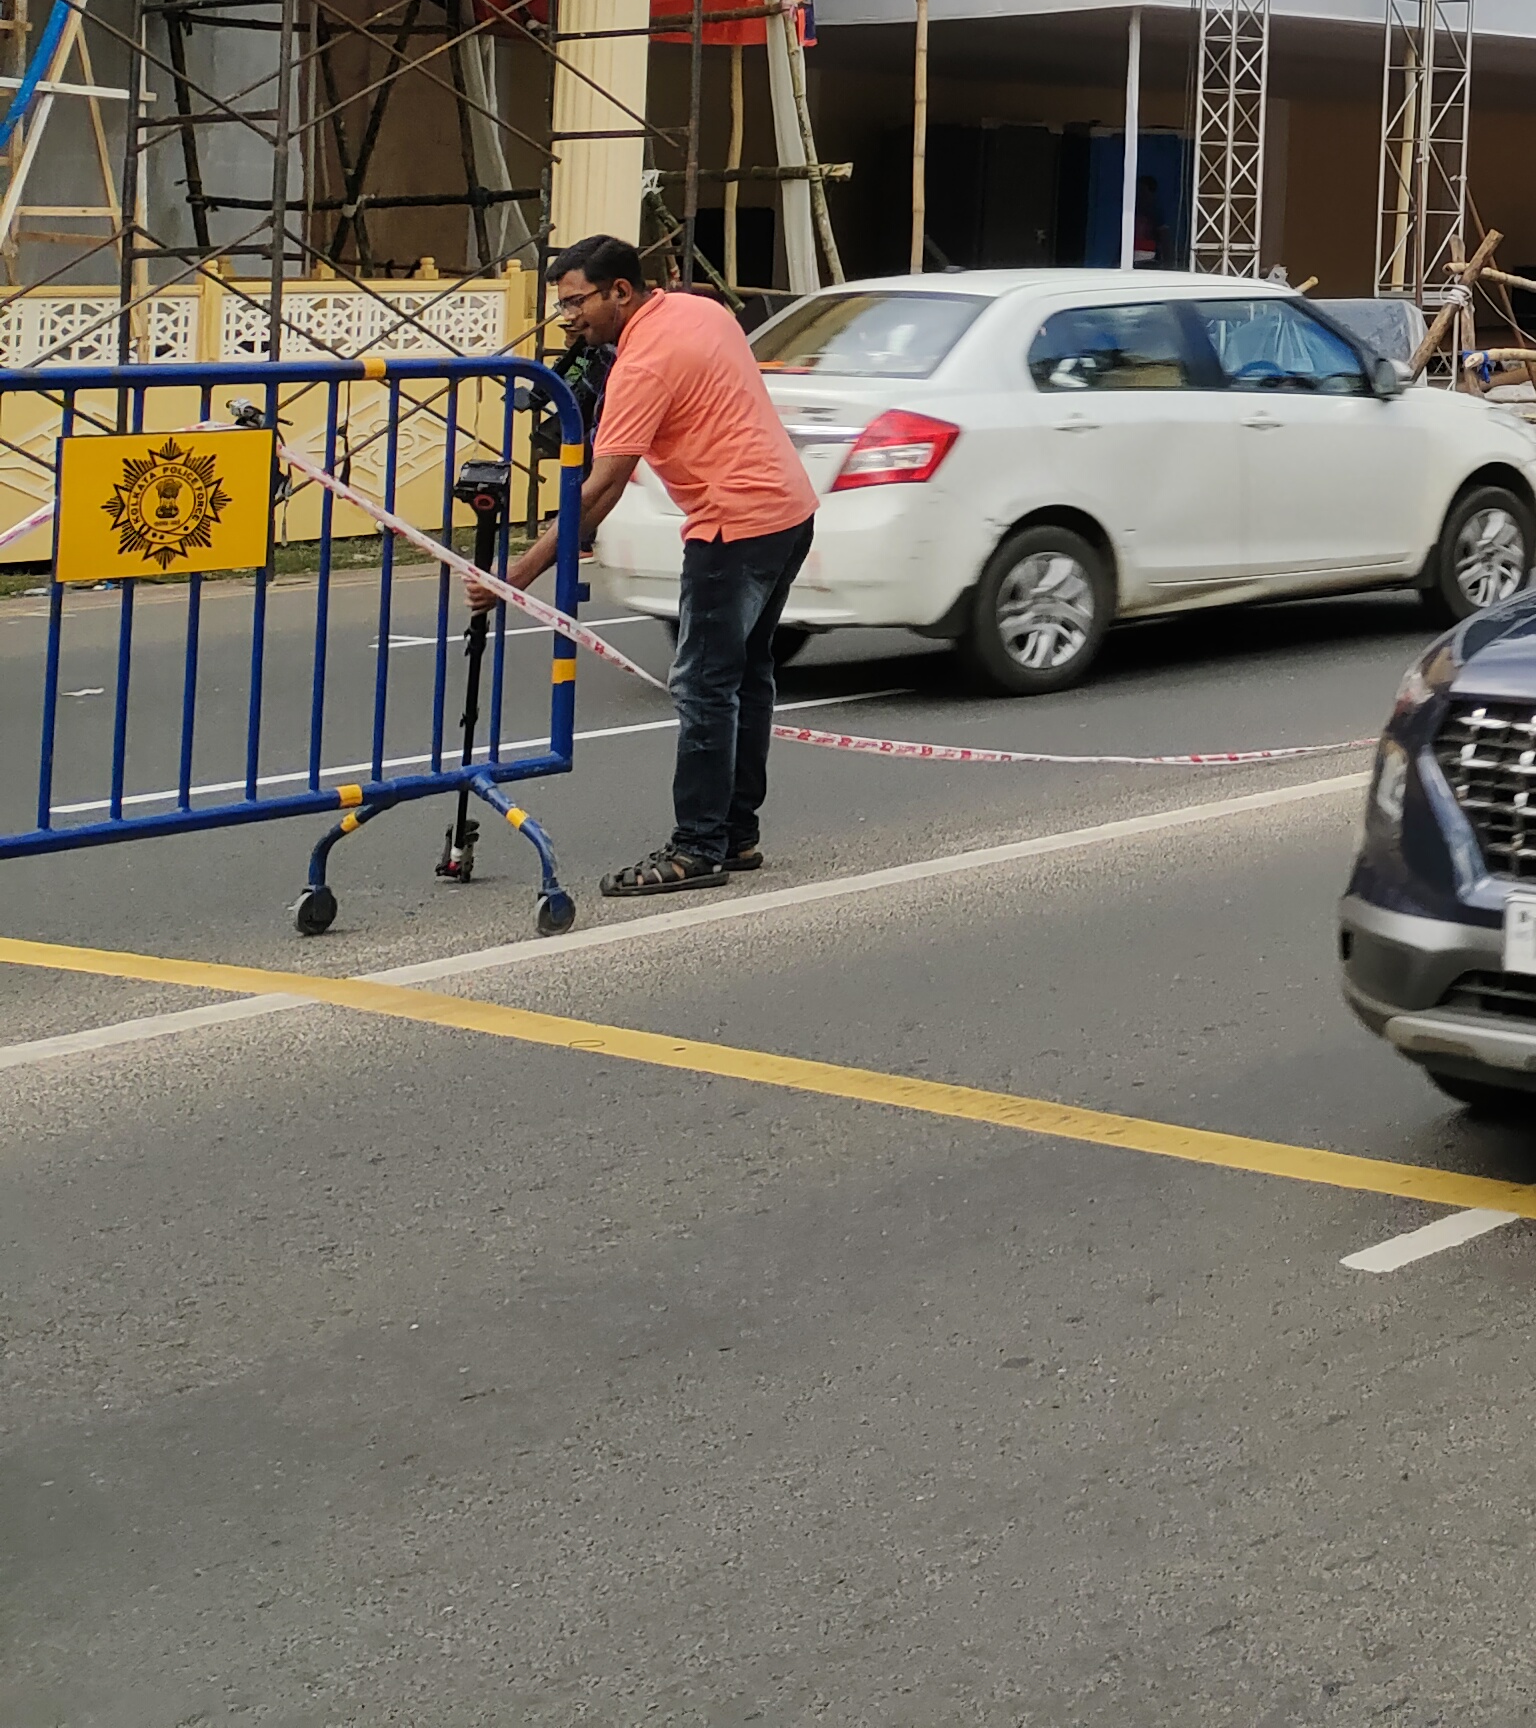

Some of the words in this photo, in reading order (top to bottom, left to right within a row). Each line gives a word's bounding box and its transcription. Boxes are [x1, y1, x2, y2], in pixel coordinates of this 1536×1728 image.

[130, 472, 157, 525] KOLKATA
[162, 466, 199, 486] POLICE
[191, 486, 205, 522] FORCE
